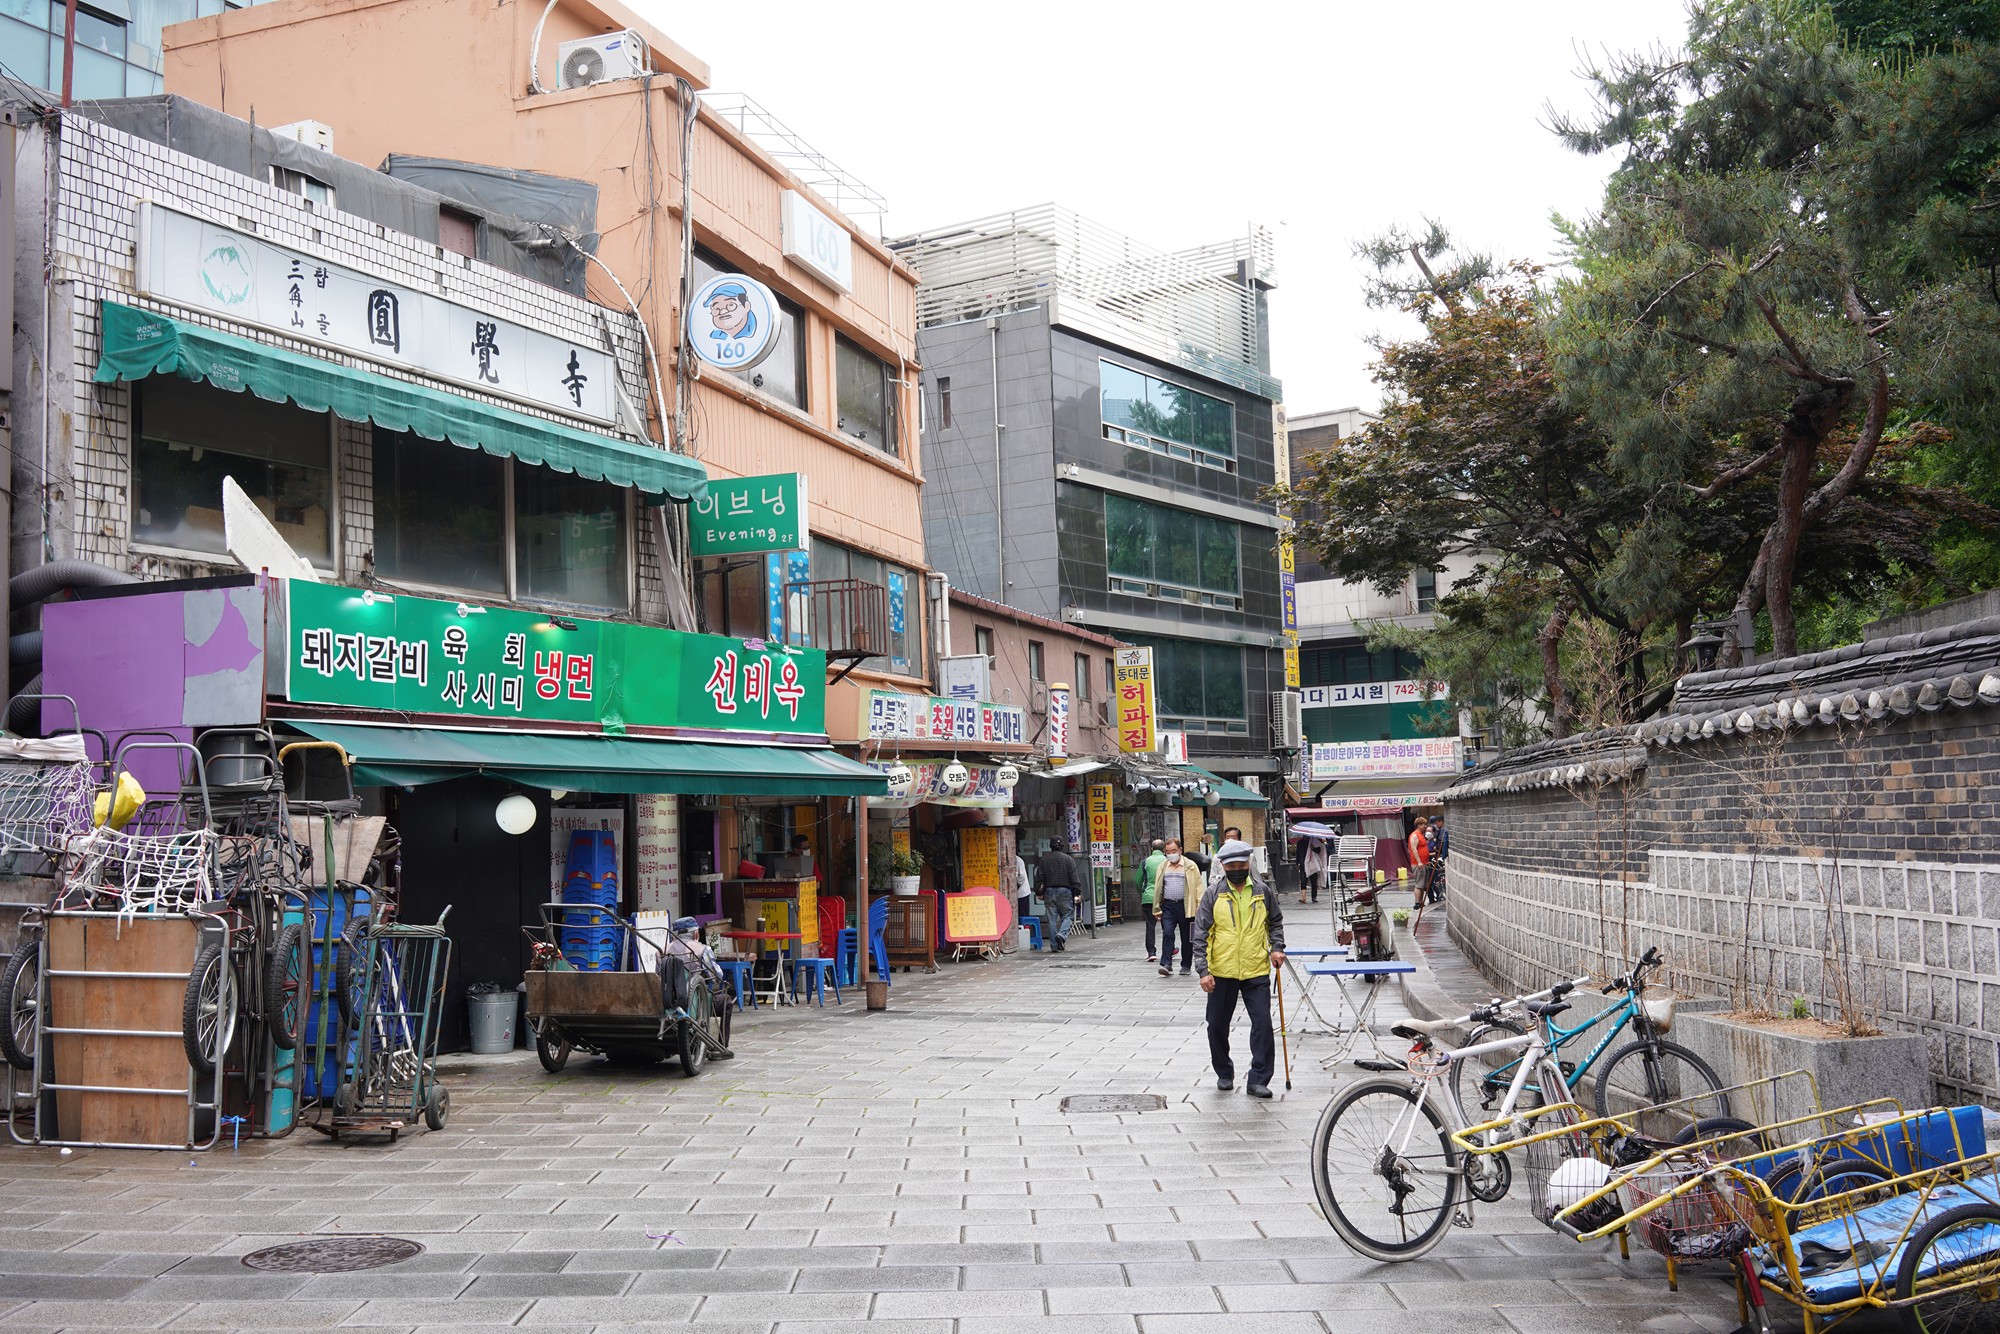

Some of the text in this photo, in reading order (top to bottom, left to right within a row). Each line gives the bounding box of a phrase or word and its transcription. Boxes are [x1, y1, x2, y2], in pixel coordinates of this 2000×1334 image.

[807, 213, 840, 272] 160
[716, 342, 746, 359] 160
[697, 485, 786, 520] 이브닝
[707, 527, 794, 543] Evening 2F
[301, 628, 428, 686] 돼지갈비
[442, 626, 526, 669] 육회
[441, 670, 524, 710] 사시미
[534, 651, 594, 701] 냉면
[705, 650, 805, 721] 선비옥
[1117, 667, 1150, 682] 동대문
[1334, 684, 1383, 701] 고시원
[932, 702, 1021, 743] 초원식당 닭한마리
[1120, 682, 1150, 749] 허파집
[1373, 743, 1423, 758] 문어숙회냉면
[890, 772, 912, 786] 모듬전
[948, 772, 966, 783] 모듬전
[1000, 770, 1017, 781] 모듬전
[1092, 787, 1109, 841] 파크이발
